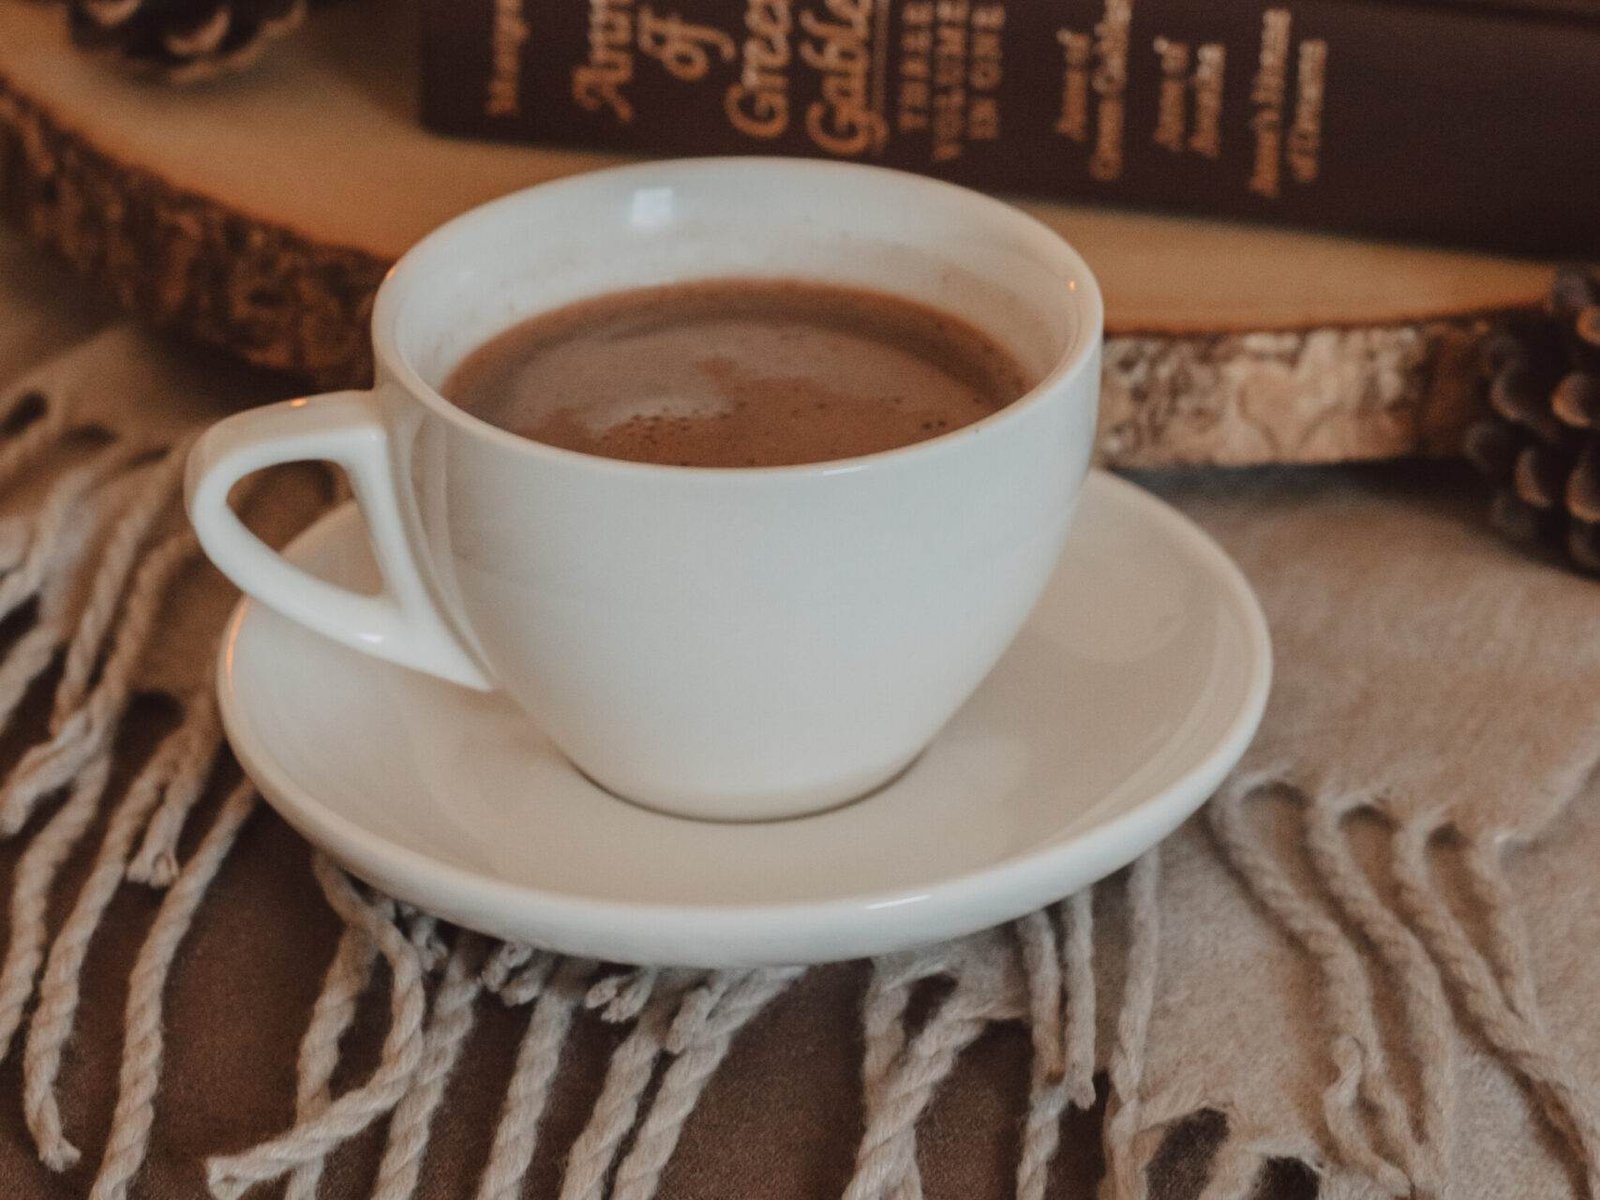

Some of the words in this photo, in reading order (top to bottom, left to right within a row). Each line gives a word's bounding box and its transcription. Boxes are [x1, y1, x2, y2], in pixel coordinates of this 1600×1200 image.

[637, 3, 738, 81] of
[900, 0, 934, 131] THREE
[968, 4, 1005, 90] ONE
[967, 98, 999, 141] IN
